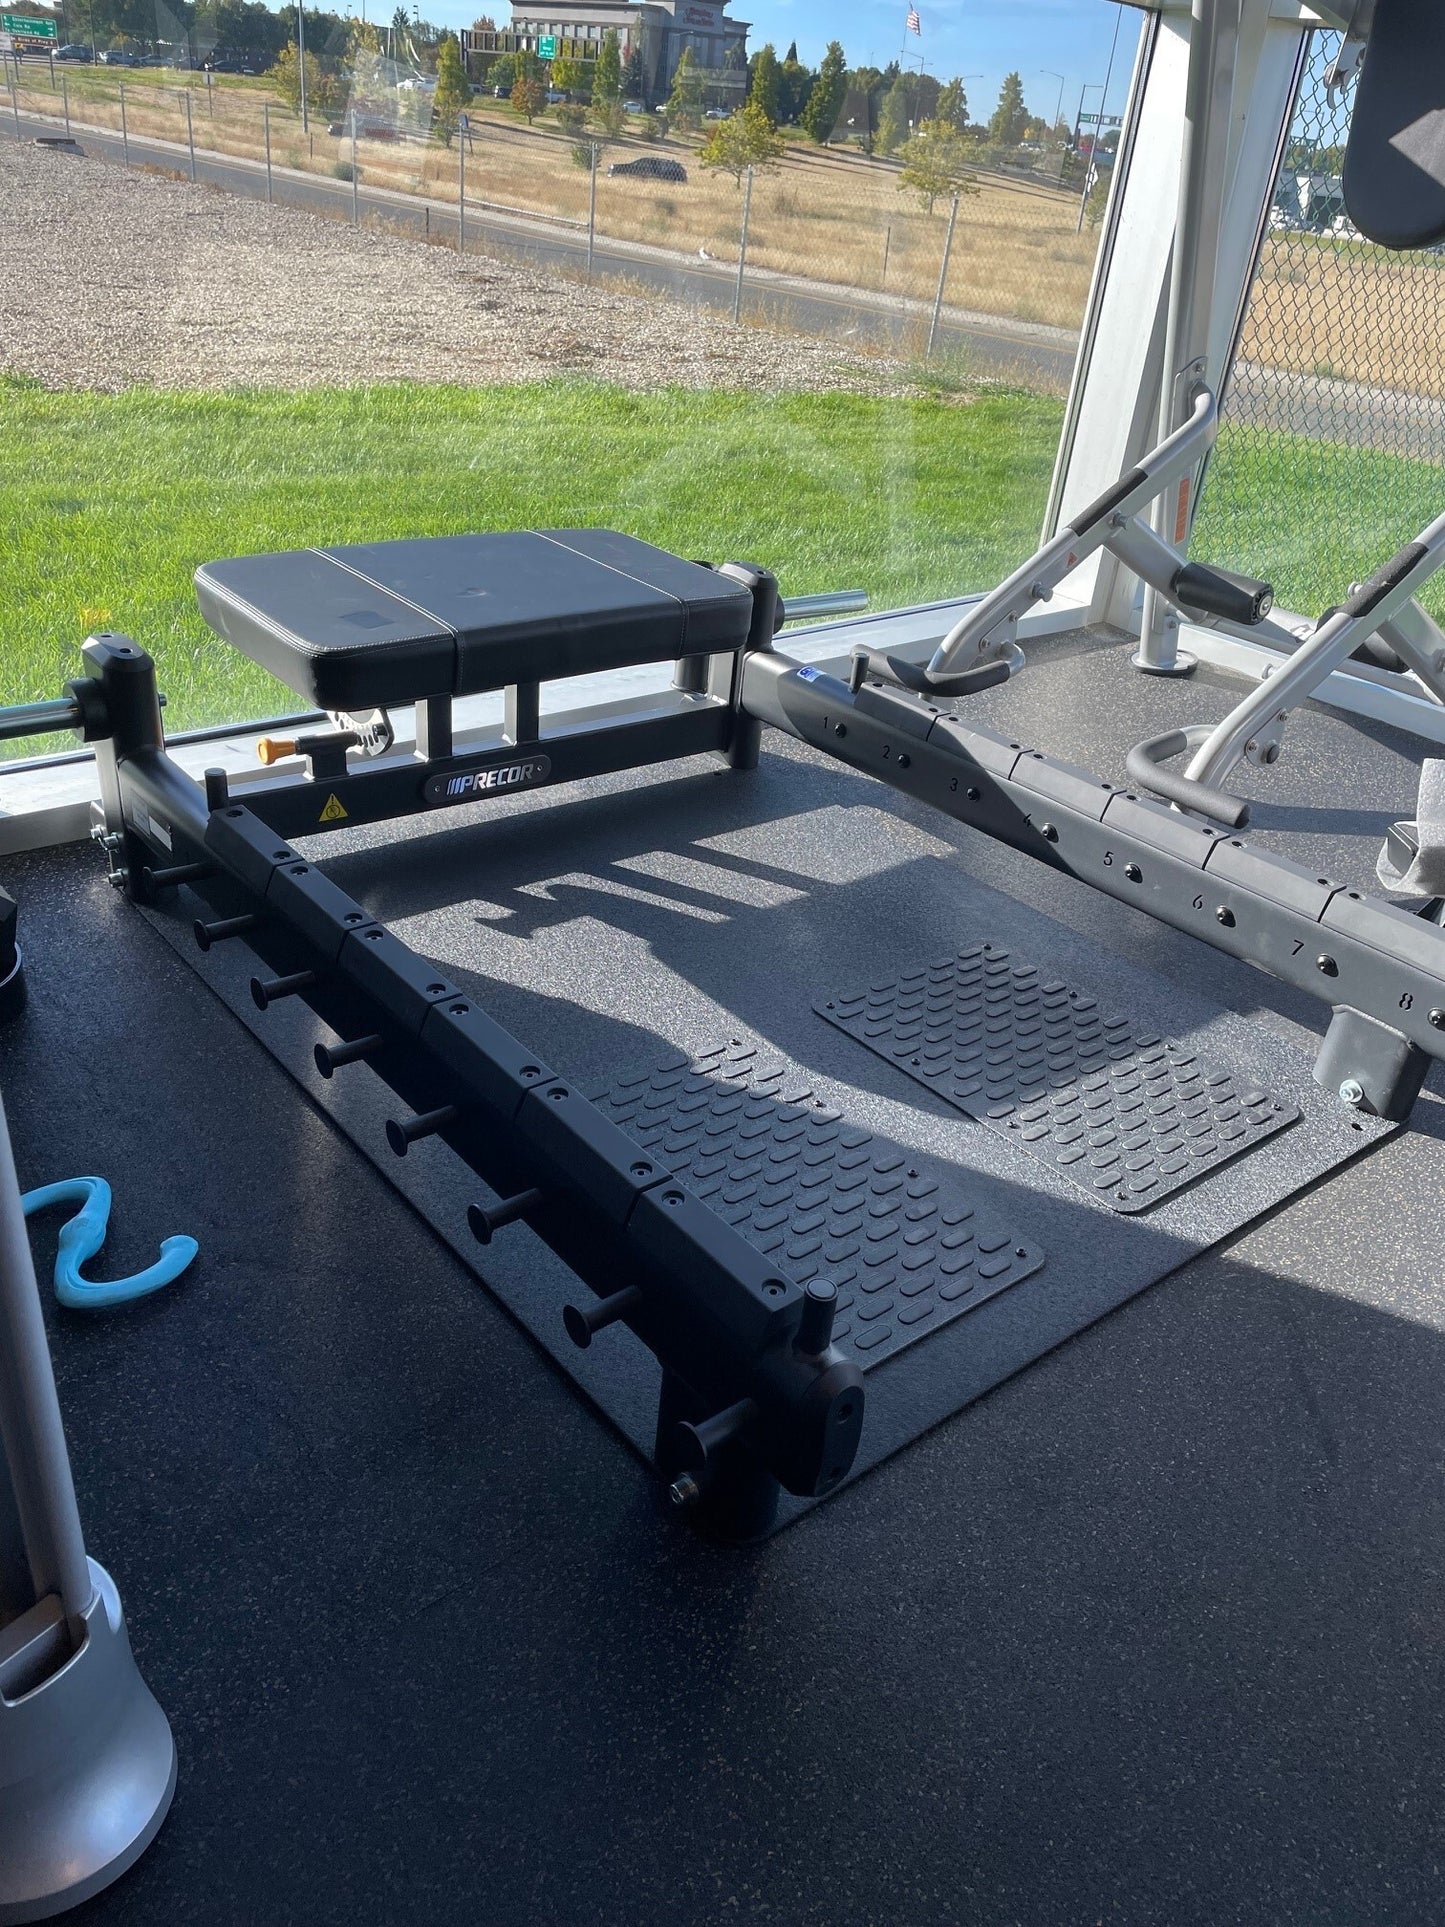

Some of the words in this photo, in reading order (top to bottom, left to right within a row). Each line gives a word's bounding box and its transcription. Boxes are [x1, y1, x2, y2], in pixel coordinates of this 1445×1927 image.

[823, 716, 829, 729] 1
[882, 745, 891, 759] 2
[459, 763, 534, 793] PRECOR
[949, 777, 959, 792] 3
[1022, 812, 1032, 828] 4
[1103, 851, 1113, 866] 5
[1192, 894, 1203, 911] 6
[1290, 939, 1305, 956] 7
[1398, 992, 1413, 1010] 8
